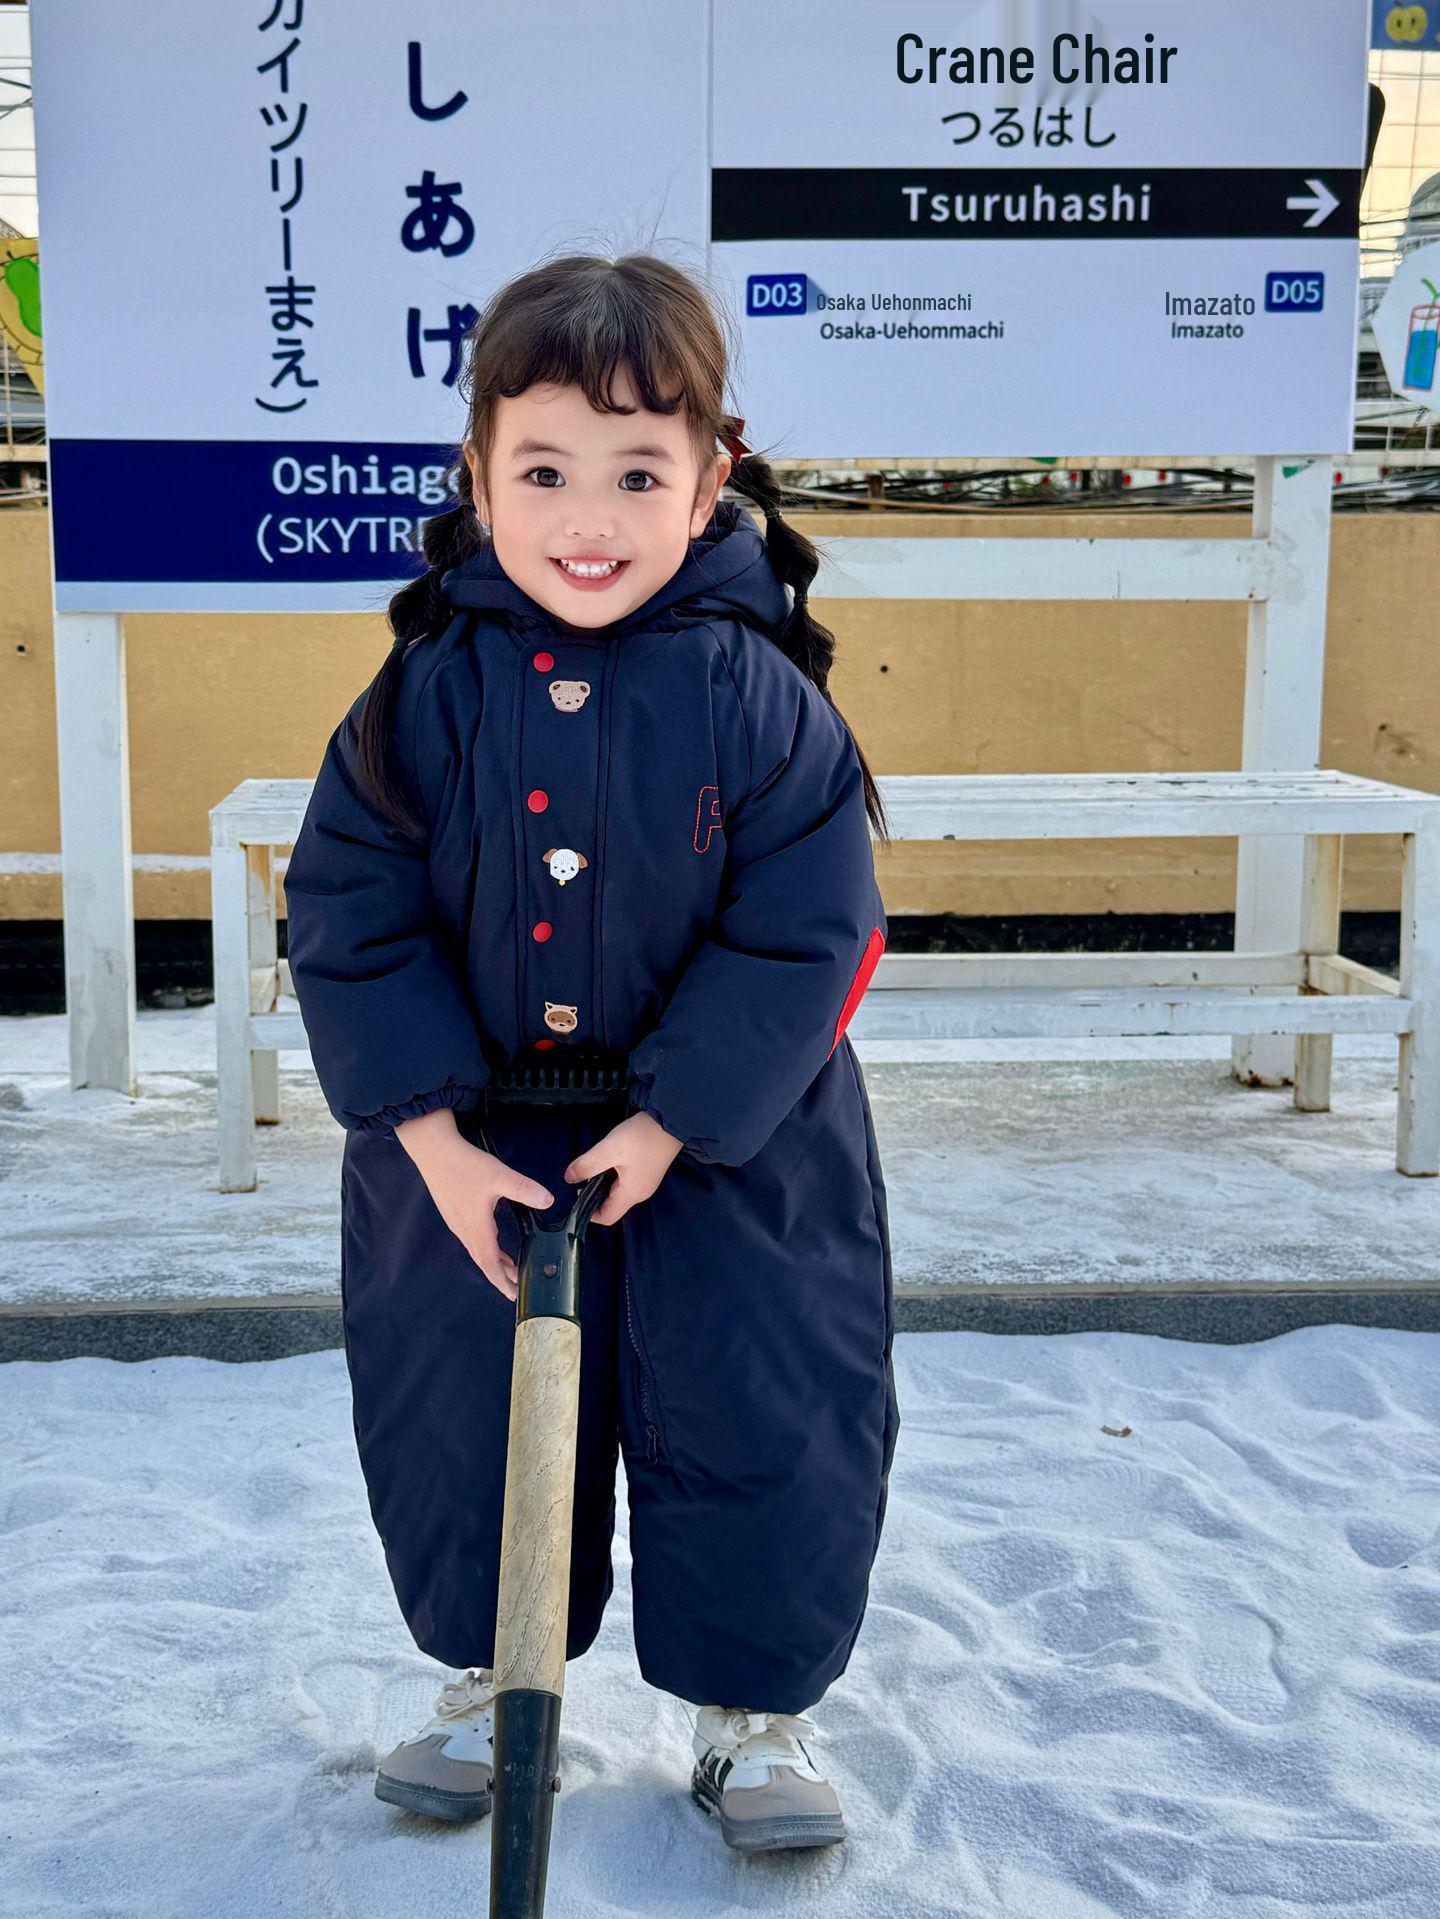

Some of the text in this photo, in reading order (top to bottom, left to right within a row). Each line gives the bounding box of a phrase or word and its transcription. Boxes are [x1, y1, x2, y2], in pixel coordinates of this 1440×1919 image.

[941, 106, 1116, 148] つるはし
[401, 41, 479, 388] しあげ
[901, 184, 1151, 222] Tsuruhashi
[752, 283, 803, 308] D03
[1271, 280, 1320, 304] D05
[820, 321, 1004, 340] Osaka-Uehommachi
[1171, 322, 1244, 339] Imazato
